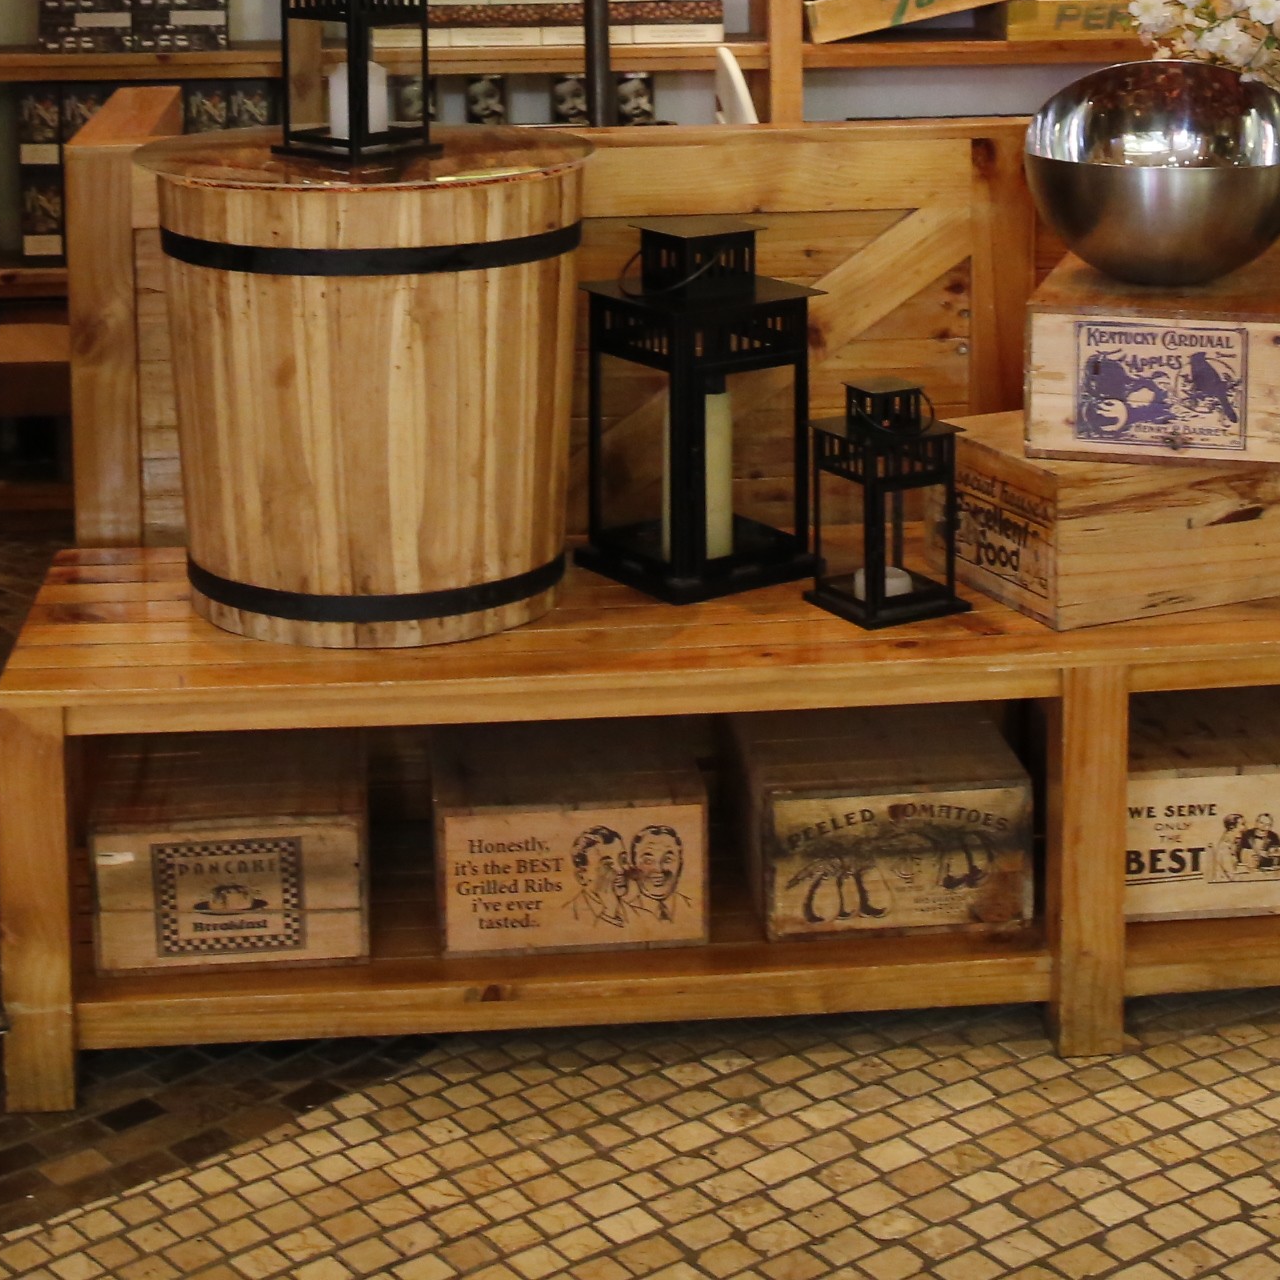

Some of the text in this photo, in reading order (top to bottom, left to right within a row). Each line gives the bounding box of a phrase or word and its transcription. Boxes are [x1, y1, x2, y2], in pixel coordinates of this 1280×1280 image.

[1086, 326, 1235, 350] KENTUCKY CARDINAL
[1125, 354, 1183, 373] APPLES
[888, 802, 1010, 833] OMATOES
[1127, 803, 1218, 819] WE SERVE
[1154, 822, 1192, 832] ONLY
[454, 857, 564, 876] it's the BEST
[1125, 847, 1206, 876] BEST
[456, 877, 563, 896] Grilled Ribs
[506, 900, 543, 912] ever
